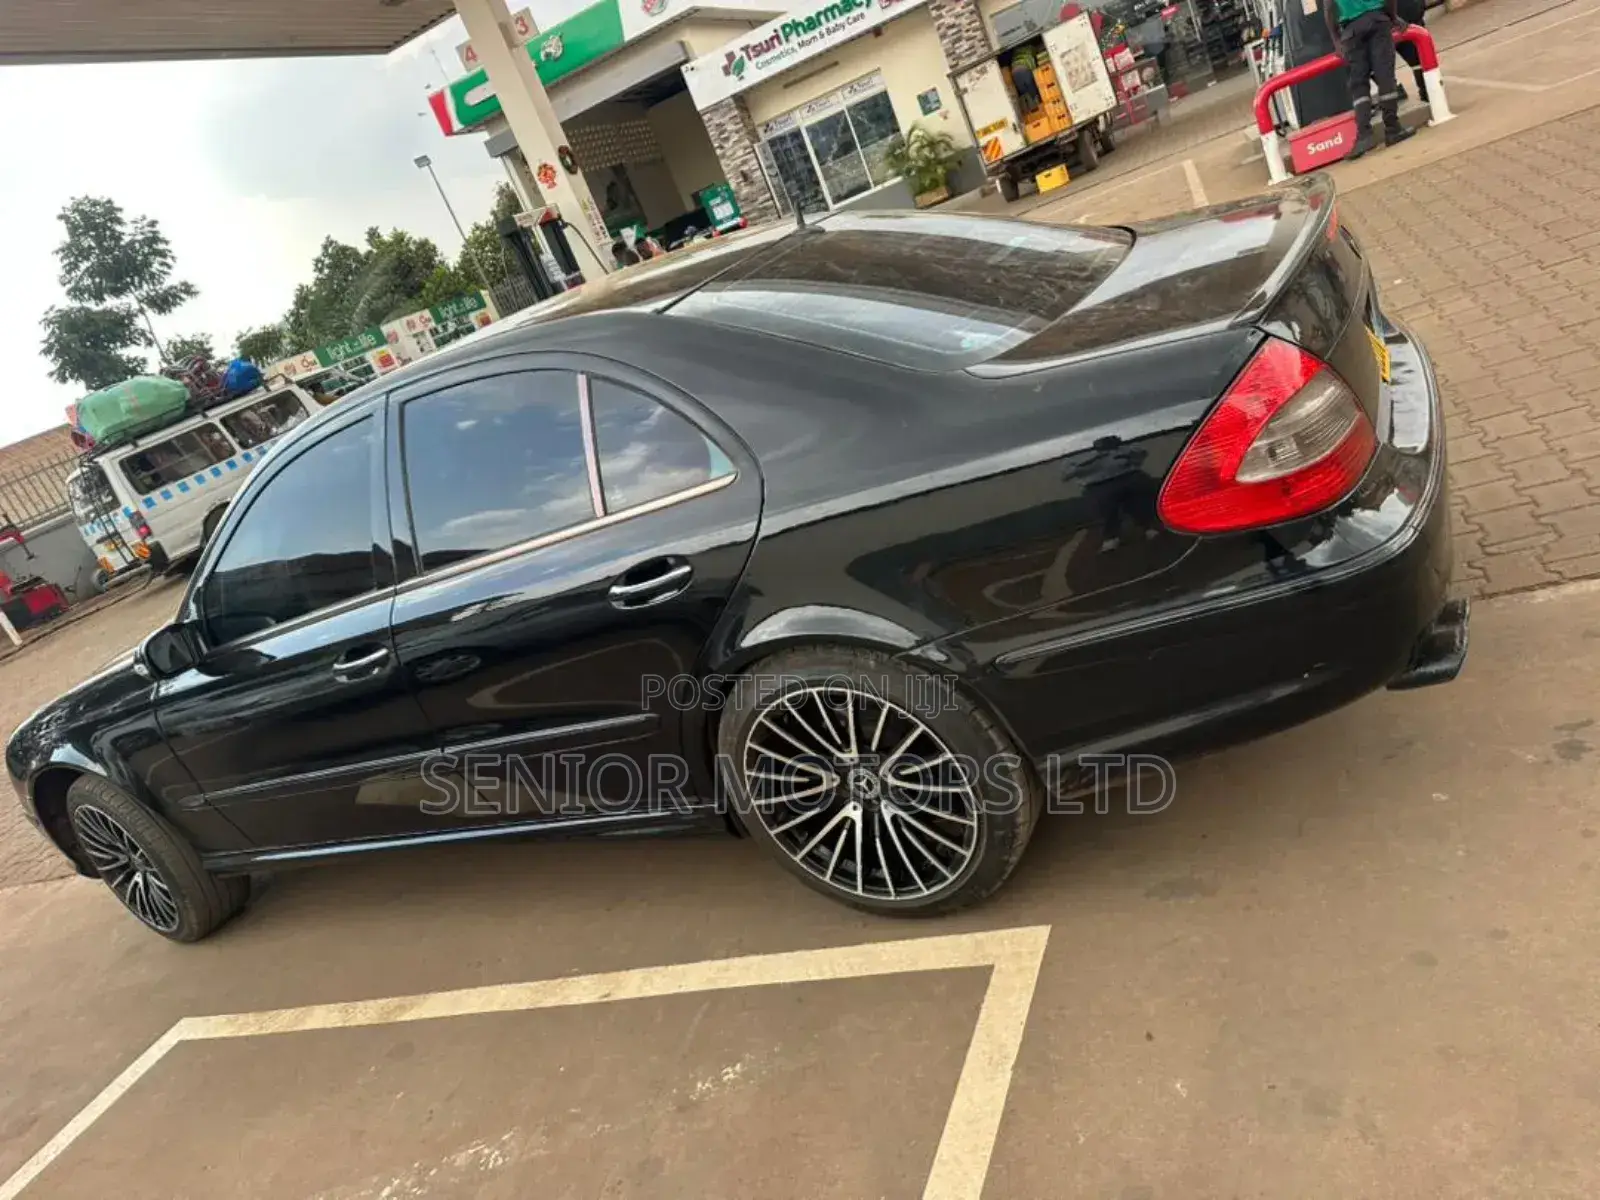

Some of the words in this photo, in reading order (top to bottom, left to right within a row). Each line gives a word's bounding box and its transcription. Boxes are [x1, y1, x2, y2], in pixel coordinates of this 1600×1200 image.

[515, 16, 529, 36] 3
[797, 31, 819, 49] Mom
[818, 30, 826, 40] &
[825, 19, 847, 36] Baby
[846, 11, 866, 26] Care
[465, 45, 477, 62] 4
[740, 29, 783, 61] Tsuri
[1307, 132, 1343, 155] Sand
